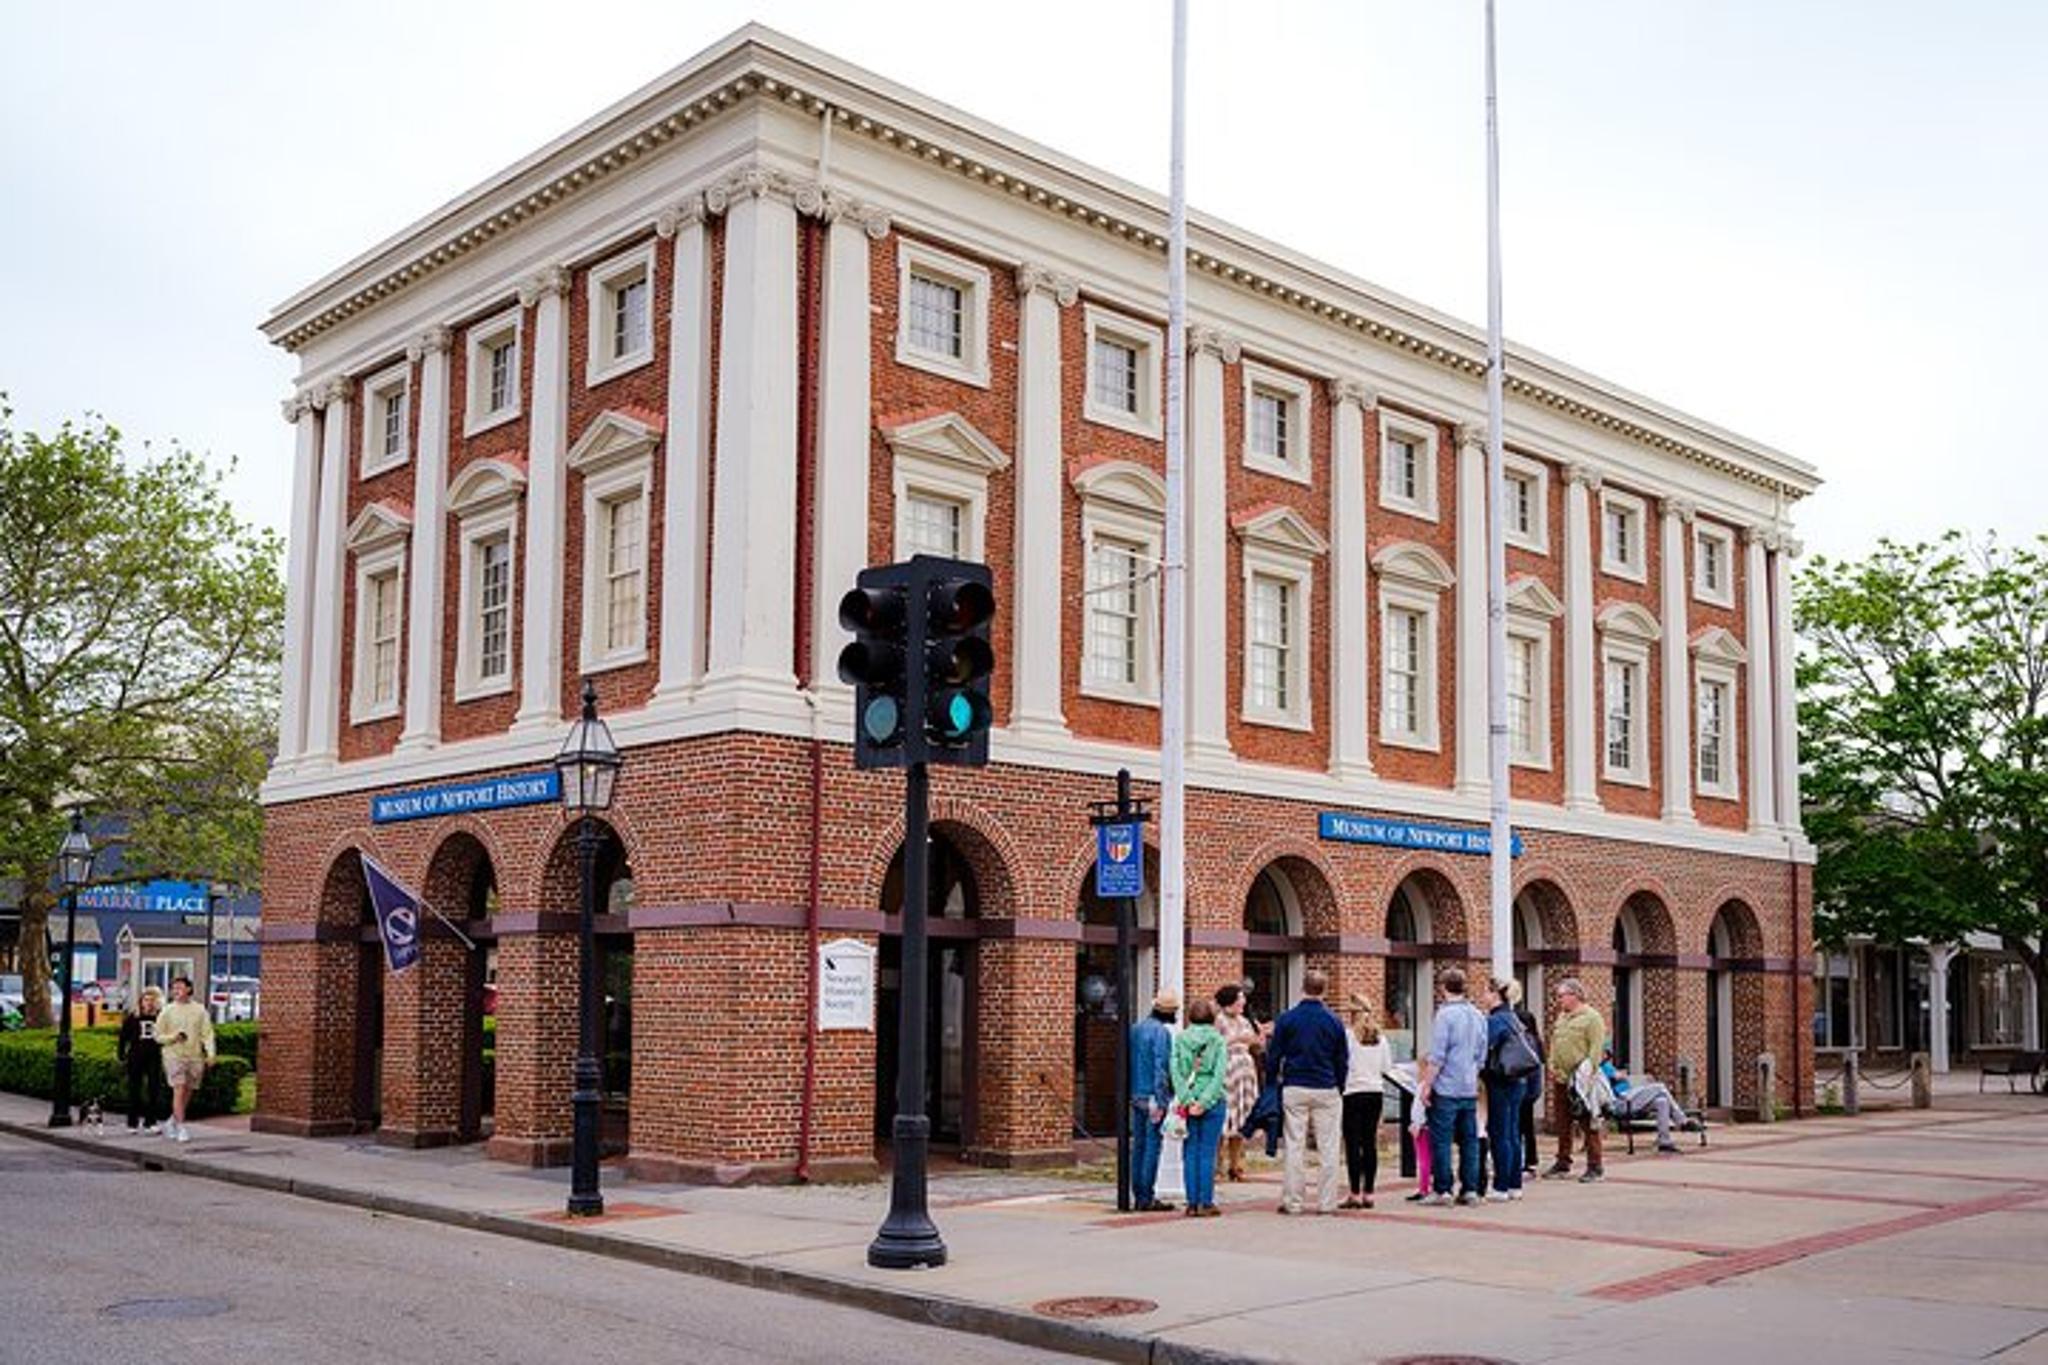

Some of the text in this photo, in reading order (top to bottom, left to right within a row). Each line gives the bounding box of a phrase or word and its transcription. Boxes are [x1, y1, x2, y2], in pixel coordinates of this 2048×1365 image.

[440, 787, 494, 808] NEWPORT
[496, 779, 549, 800] HISTORY
[1332, 818, 1386, 842] MUSEUM
[1388, 826, 1404, 840] OF
[1407, 826, 1463, 849] NEWPORT
[84, 894, 204, 911] MARKET PLACE
[825, 972, 862, 985] Newport
